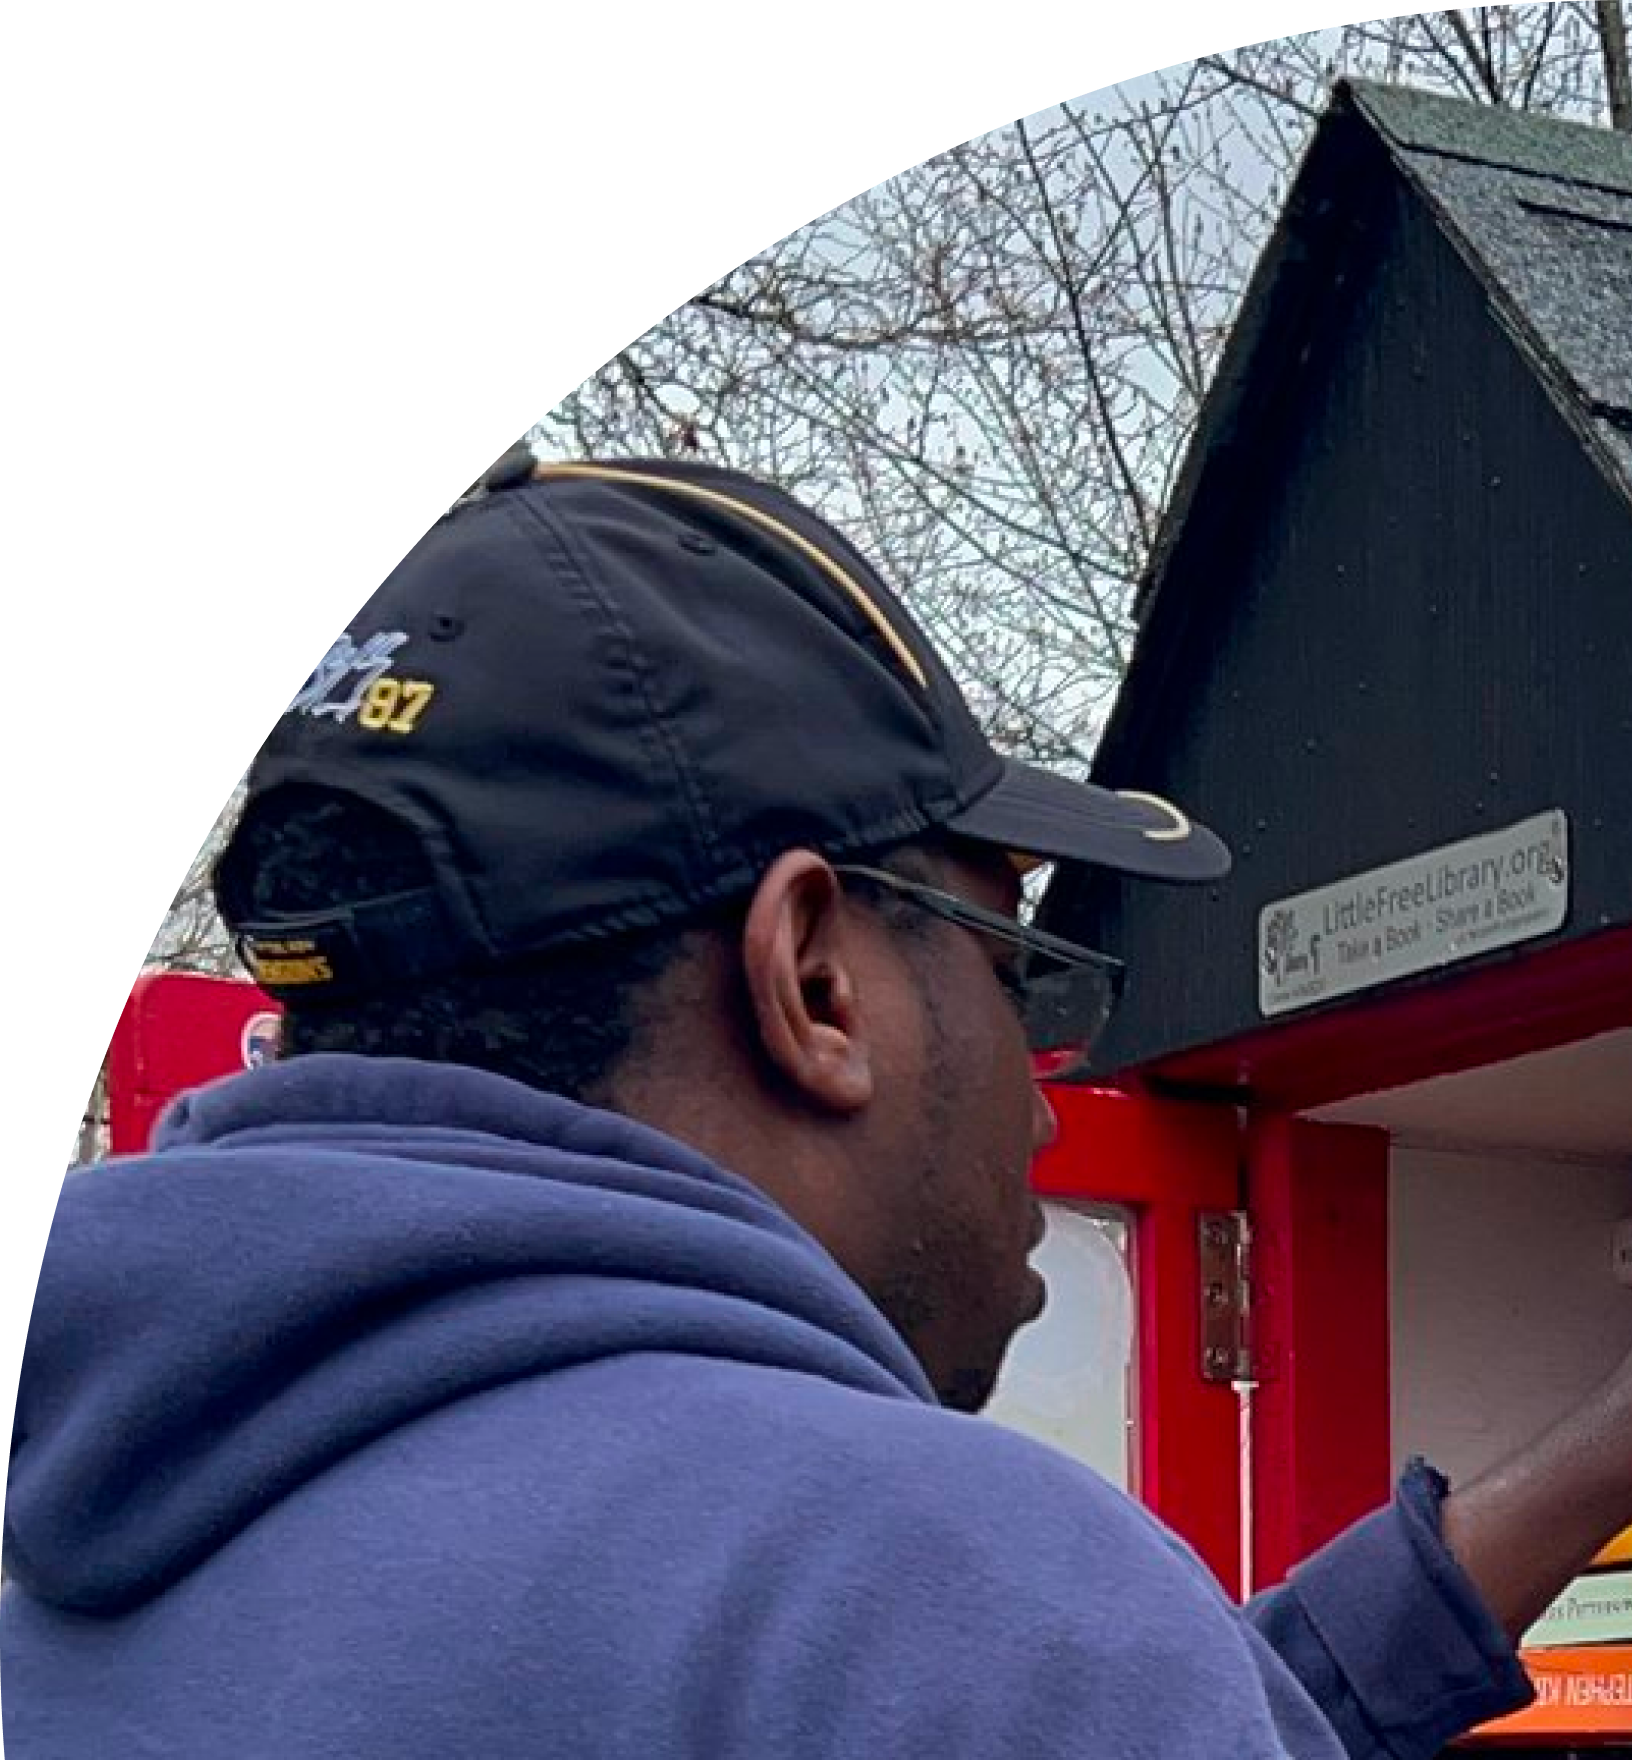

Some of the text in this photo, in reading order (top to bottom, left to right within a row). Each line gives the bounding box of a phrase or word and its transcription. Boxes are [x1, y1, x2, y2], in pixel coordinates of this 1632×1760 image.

[1322, 839, 1551, 936] LittleFreeLibrary.org
[1336, 939, 1372, 965] Take
[1373, 936, 1383, 958] a
[1385, 919, 1421, 951] Book
[1435, 901, 1480, 934] Share
[1483, 896, 1493, 918] a
[1498, 882, 1535, 914] Book
